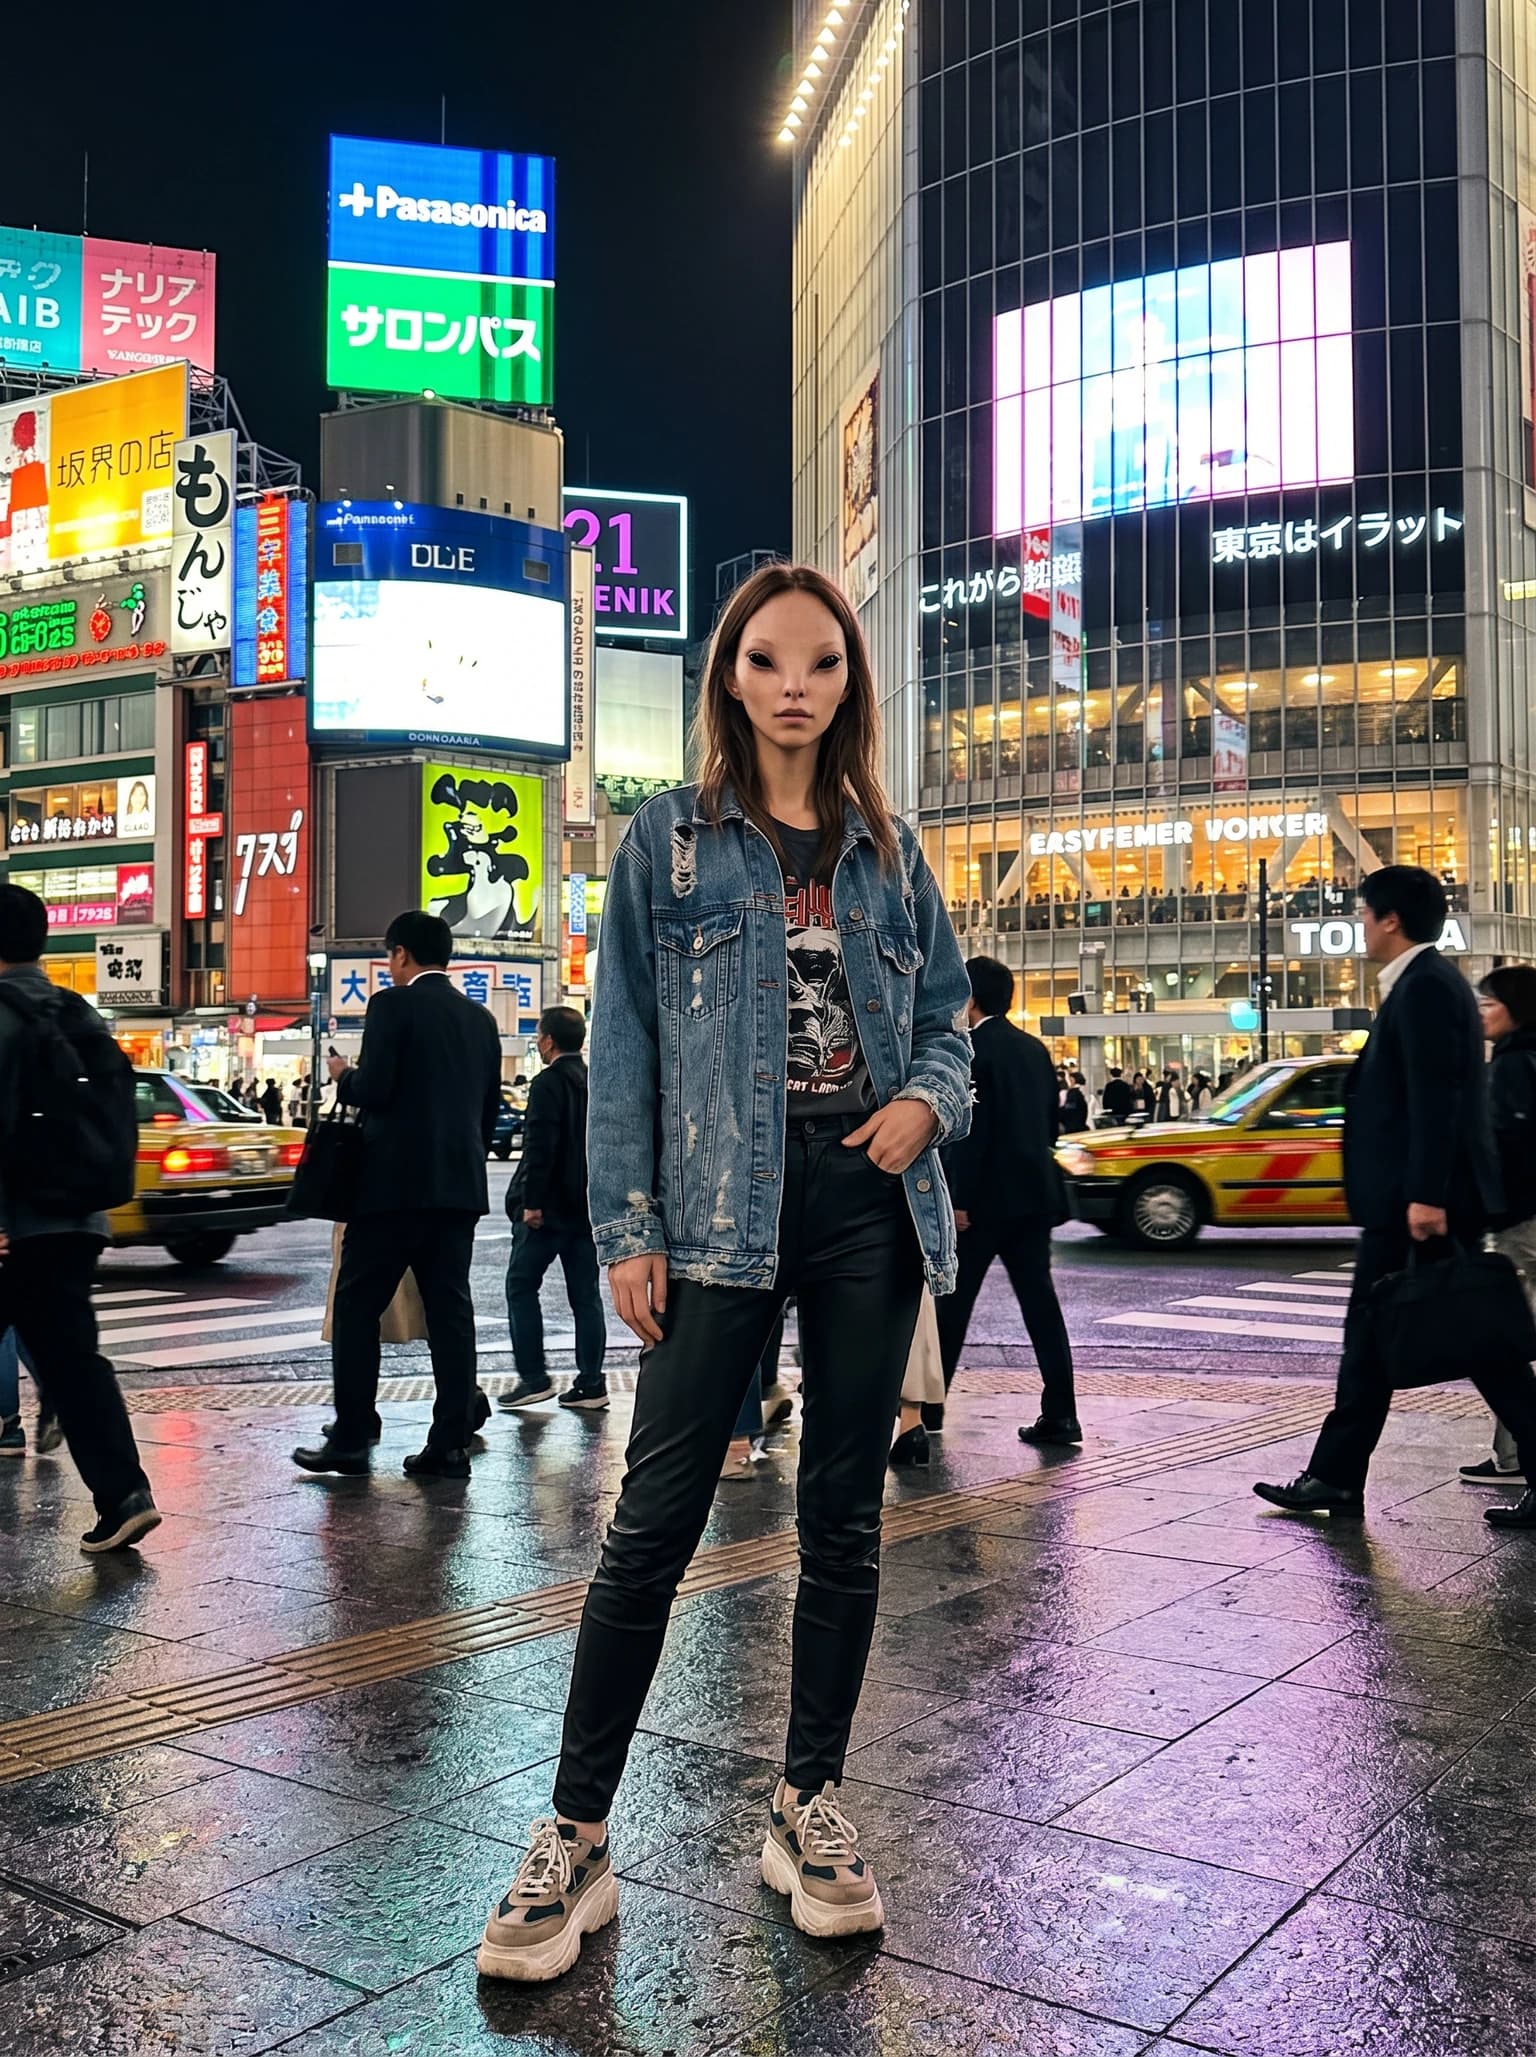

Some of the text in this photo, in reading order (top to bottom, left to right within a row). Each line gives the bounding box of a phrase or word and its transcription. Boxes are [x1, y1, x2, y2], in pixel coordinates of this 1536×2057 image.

[100, 268, 197, 307] ナリア
[100, 305, 197, 342] テック
[341, 304, 541, 362] サロンパス
[57, 430, 174, 488] 坂界の店
[175, 444, 231, 640] もんじゃ
[1212, 507, 1463, 563] 東京はイラット
[1291, 919, 1467, 955] TOA
